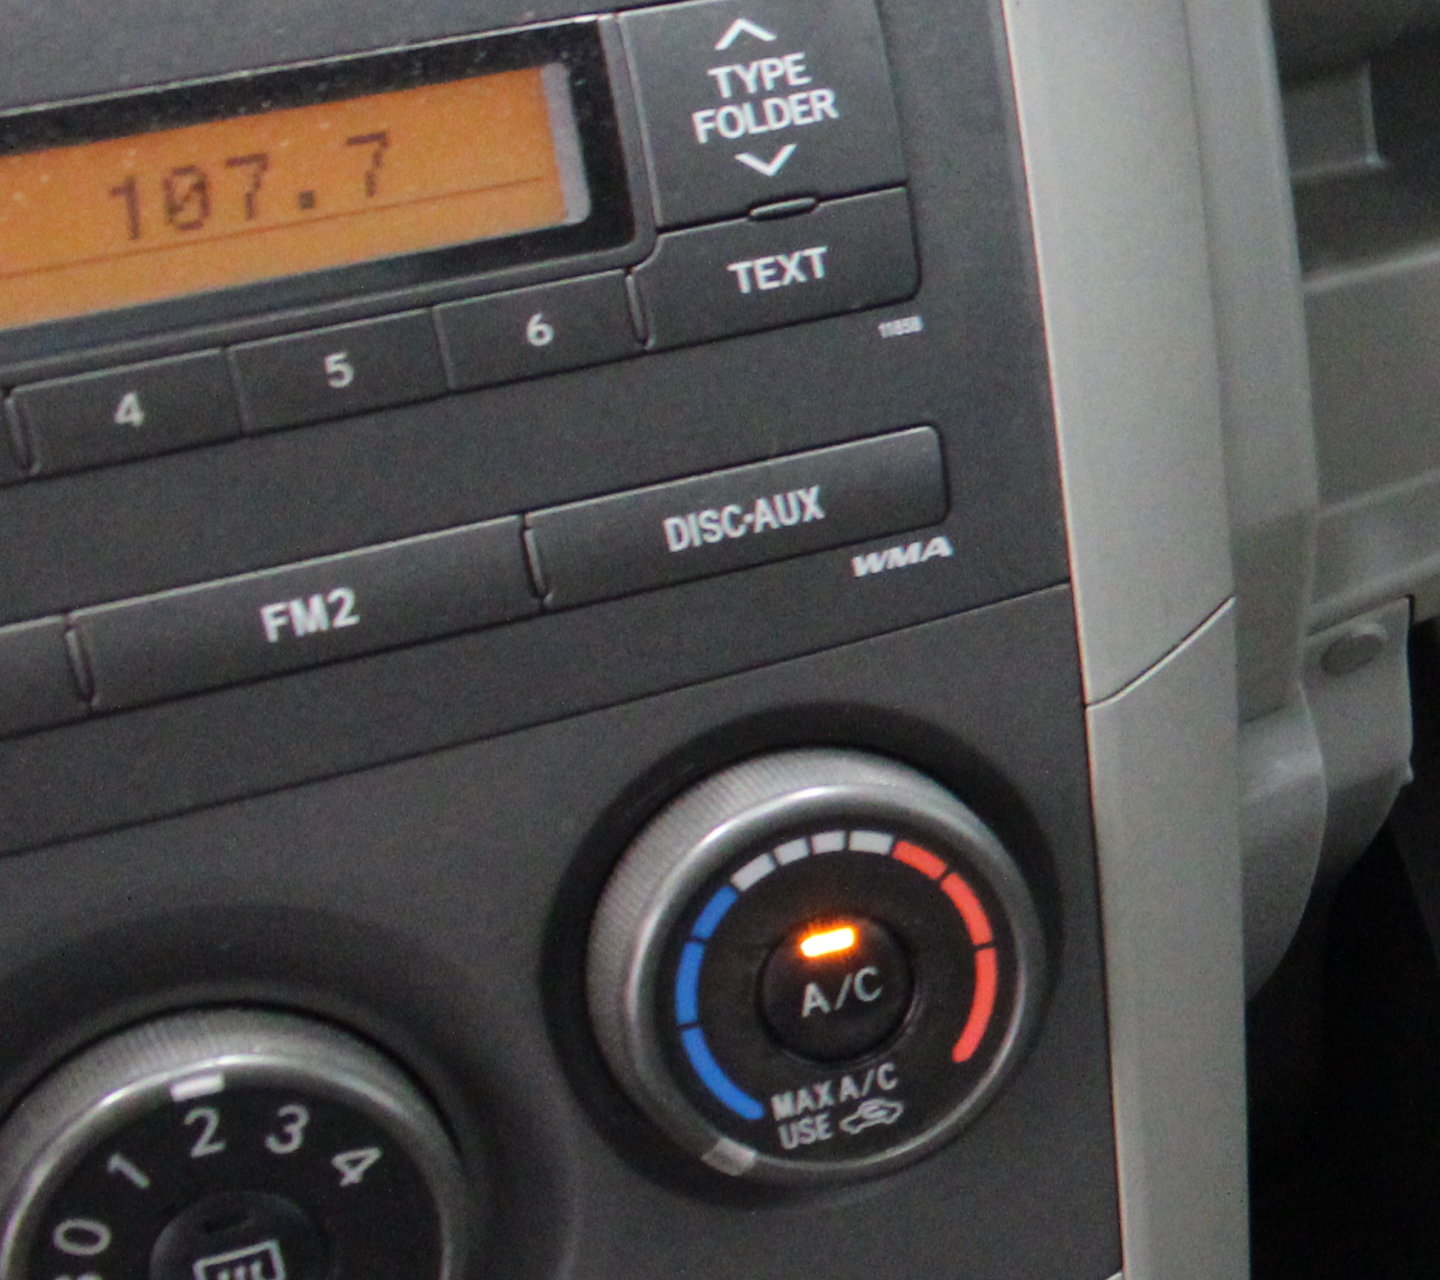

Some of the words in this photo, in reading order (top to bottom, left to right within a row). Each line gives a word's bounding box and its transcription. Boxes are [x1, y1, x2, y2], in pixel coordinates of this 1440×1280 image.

[707, 51, 812, 99] TYPE
[692, 87, 840, 144] FOLDER
[109, 131, 391, 241] 107.7
[727, 245, 829, 294] TEXT
[525, 313, 555, 347] 6
[323, 352, 355, 388] 5
[114, 391, 144, 428] 4
[851, 535, 954, 578] WMA
[260, 586, 360, 644] FM2
[802, 966, 884, 1018] A/C
[771, 1080, 834, 1121] MAX
[839, 1062, 899, 1103] A/C
[777, 1113, 834, 1150] USE
[52, 1218, 112, 1256] 0
[107, 1152, 151, 1189] 1
[183, 1106, 227, 1159] 2
[264, 1104, 310, 1154] 3
[331, 1146, 383, 1188] 4
